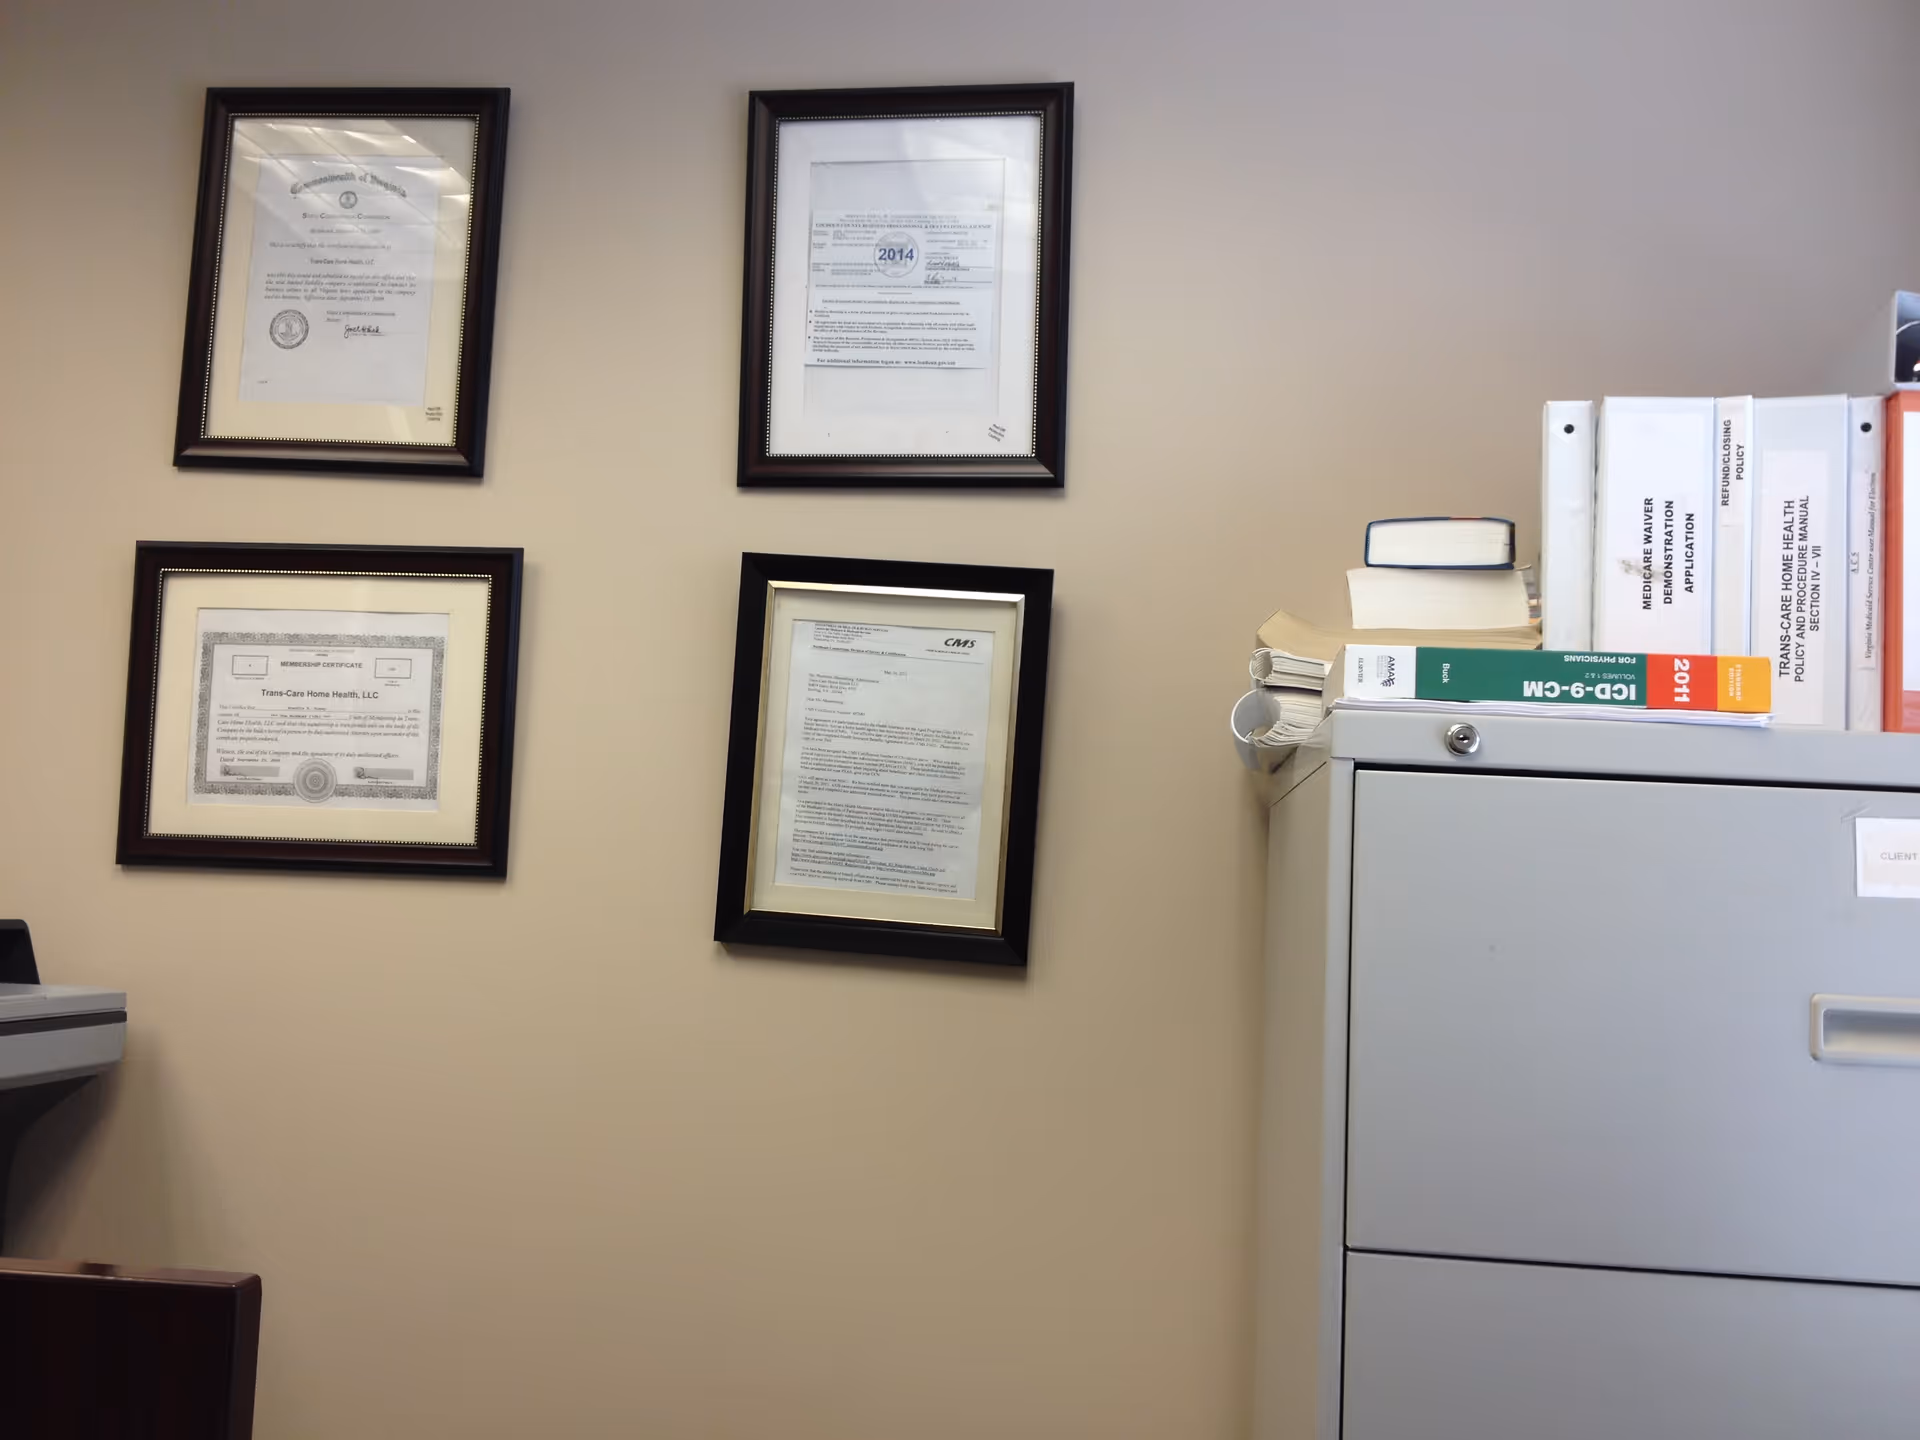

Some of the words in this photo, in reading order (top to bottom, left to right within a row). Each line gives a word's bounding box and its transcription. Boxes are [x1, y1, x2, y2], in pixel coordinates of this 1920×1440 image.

[878, 248, 915, 261] 2014
[1721, 419, 1732, 506] REFUND/CLOSING
[1736, 443, 1745, 480] POLICY
[1644, 497, 1653, 545] WAIVER
[1783, 500, 1795, 549] HEALTH
[1798, 495, 1809, 542] MANUAL
[1664, 500, 1674, 604] DEMONSTRATION
[1685, 512, 1695, 593] APPLICATION
[1812, 546, 1821, 558] VII
[1642, 547, 1653, 610] MEDICARE
[1782, 551, 1793, 592] HOME
[1796, 544, 1807, 613] PROCEDURE
[1811, 570, 1820, 583] IV
[1810, 584, 1819, 632] SECTION
[1865, 600, 1873, 630] Medicaid
[944, 637, 977, 649] CMS
[1779, 595, 1792, 678] TRANS-CARE
[1796, 614, 1806, 639] AND
[1564, 655, 1616, 663] PHYSICIANS
[1618, 656, 1636, 664] FOR
[1795, 641, 1804, 682] POLICY
[1864, 632, 1873, 659] Virginia
[1442, 663, 1450, 684] Buck
[1602, 672, 1636, 680] VOLUMES
[1673, 658, 1690, 703] 2011
[261, 689, 305, 699] Trans-Care
[307, 689, 330, 699] Home
[332, 690, 360, 700] Health,
[362, 691, 379, 699] LLC
[1523, 680, 1636, 701] ICD-9-CM
[1880, 852, 1919, 861] CLIENT
